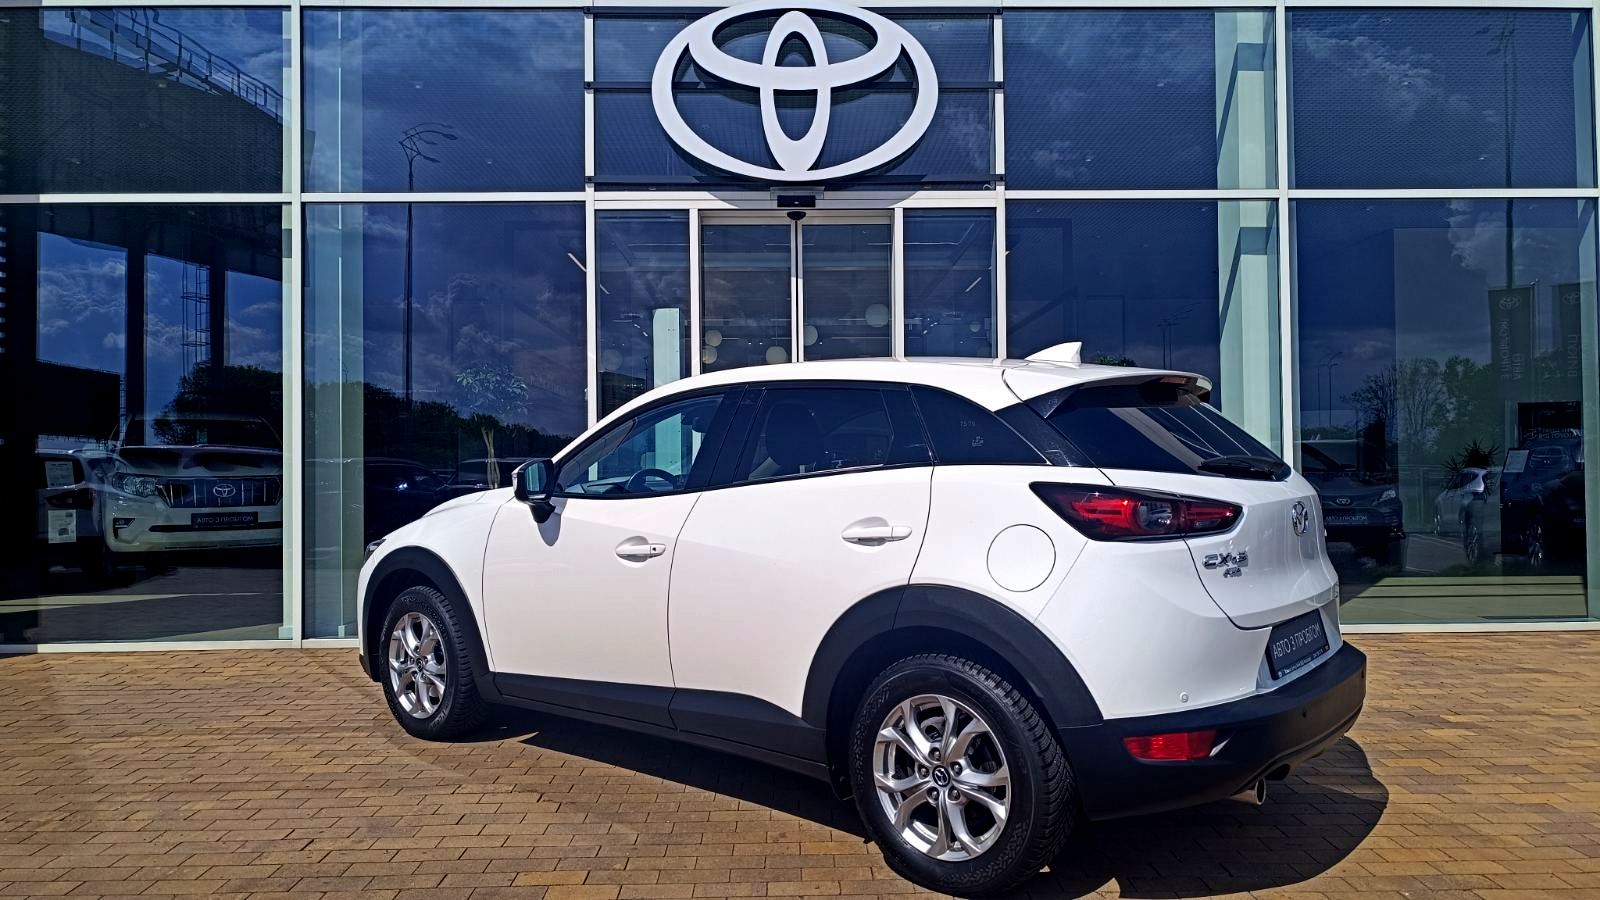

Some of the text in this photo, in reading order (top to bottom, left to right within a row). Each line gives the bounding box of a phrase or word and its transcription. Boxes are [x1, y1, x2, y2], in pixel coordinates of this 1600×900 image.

[1273, 638, 1291, 659] АВТО
[1290, 636, 1296, 651] З
[1295, 622, 1322, 647] ПРОБІГОМ
